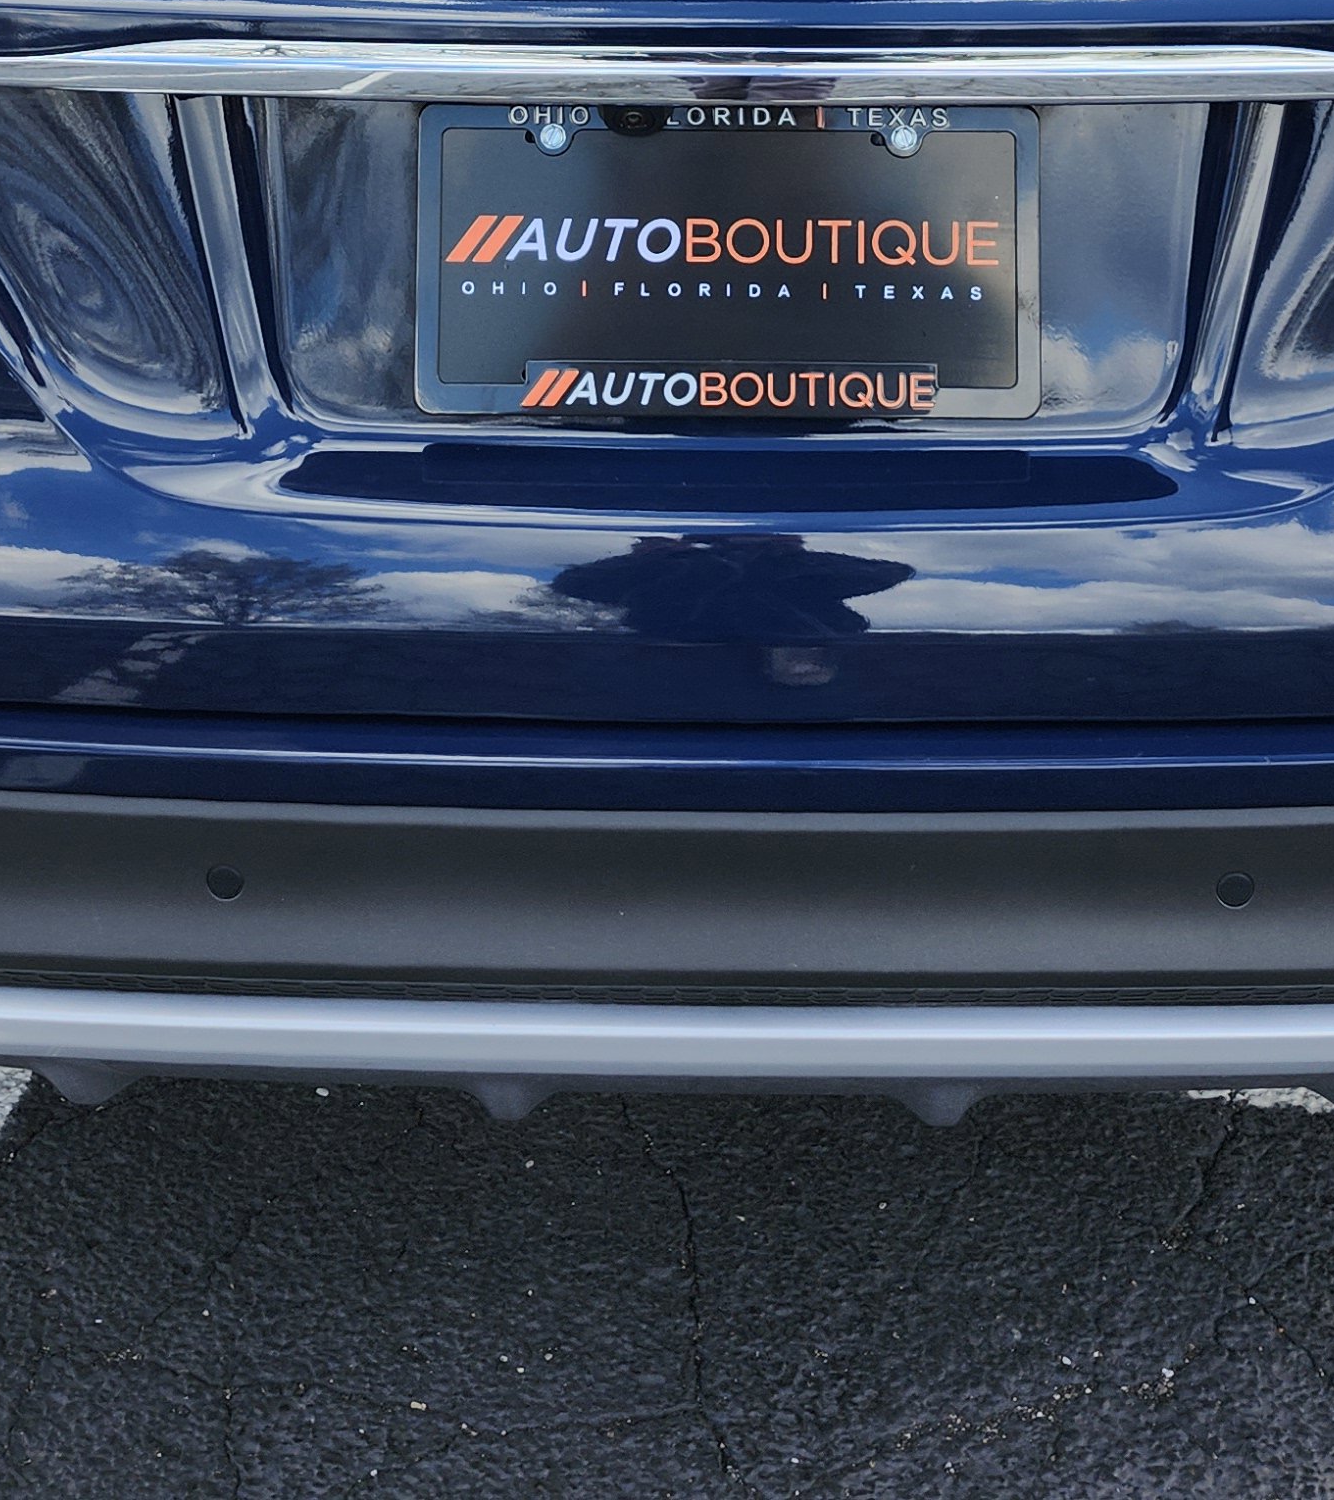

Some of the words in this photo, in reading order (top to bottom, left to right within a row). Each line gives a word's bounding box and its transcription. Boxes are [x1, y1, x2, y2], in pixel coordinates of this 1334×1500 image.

[508, 106, 589, 125] OHIO
[847, 108, 949, 128] TEXAS
[505, 218, 999, 267] AUTOBOUTIQUE
[461, 281, 557, 296] OHIO
[614, 282, 791, 299] FLORIDA
[856, 285, 982, 301] TEXAS
[566, 371, 936, 411] AUTOBOUTIQUE
